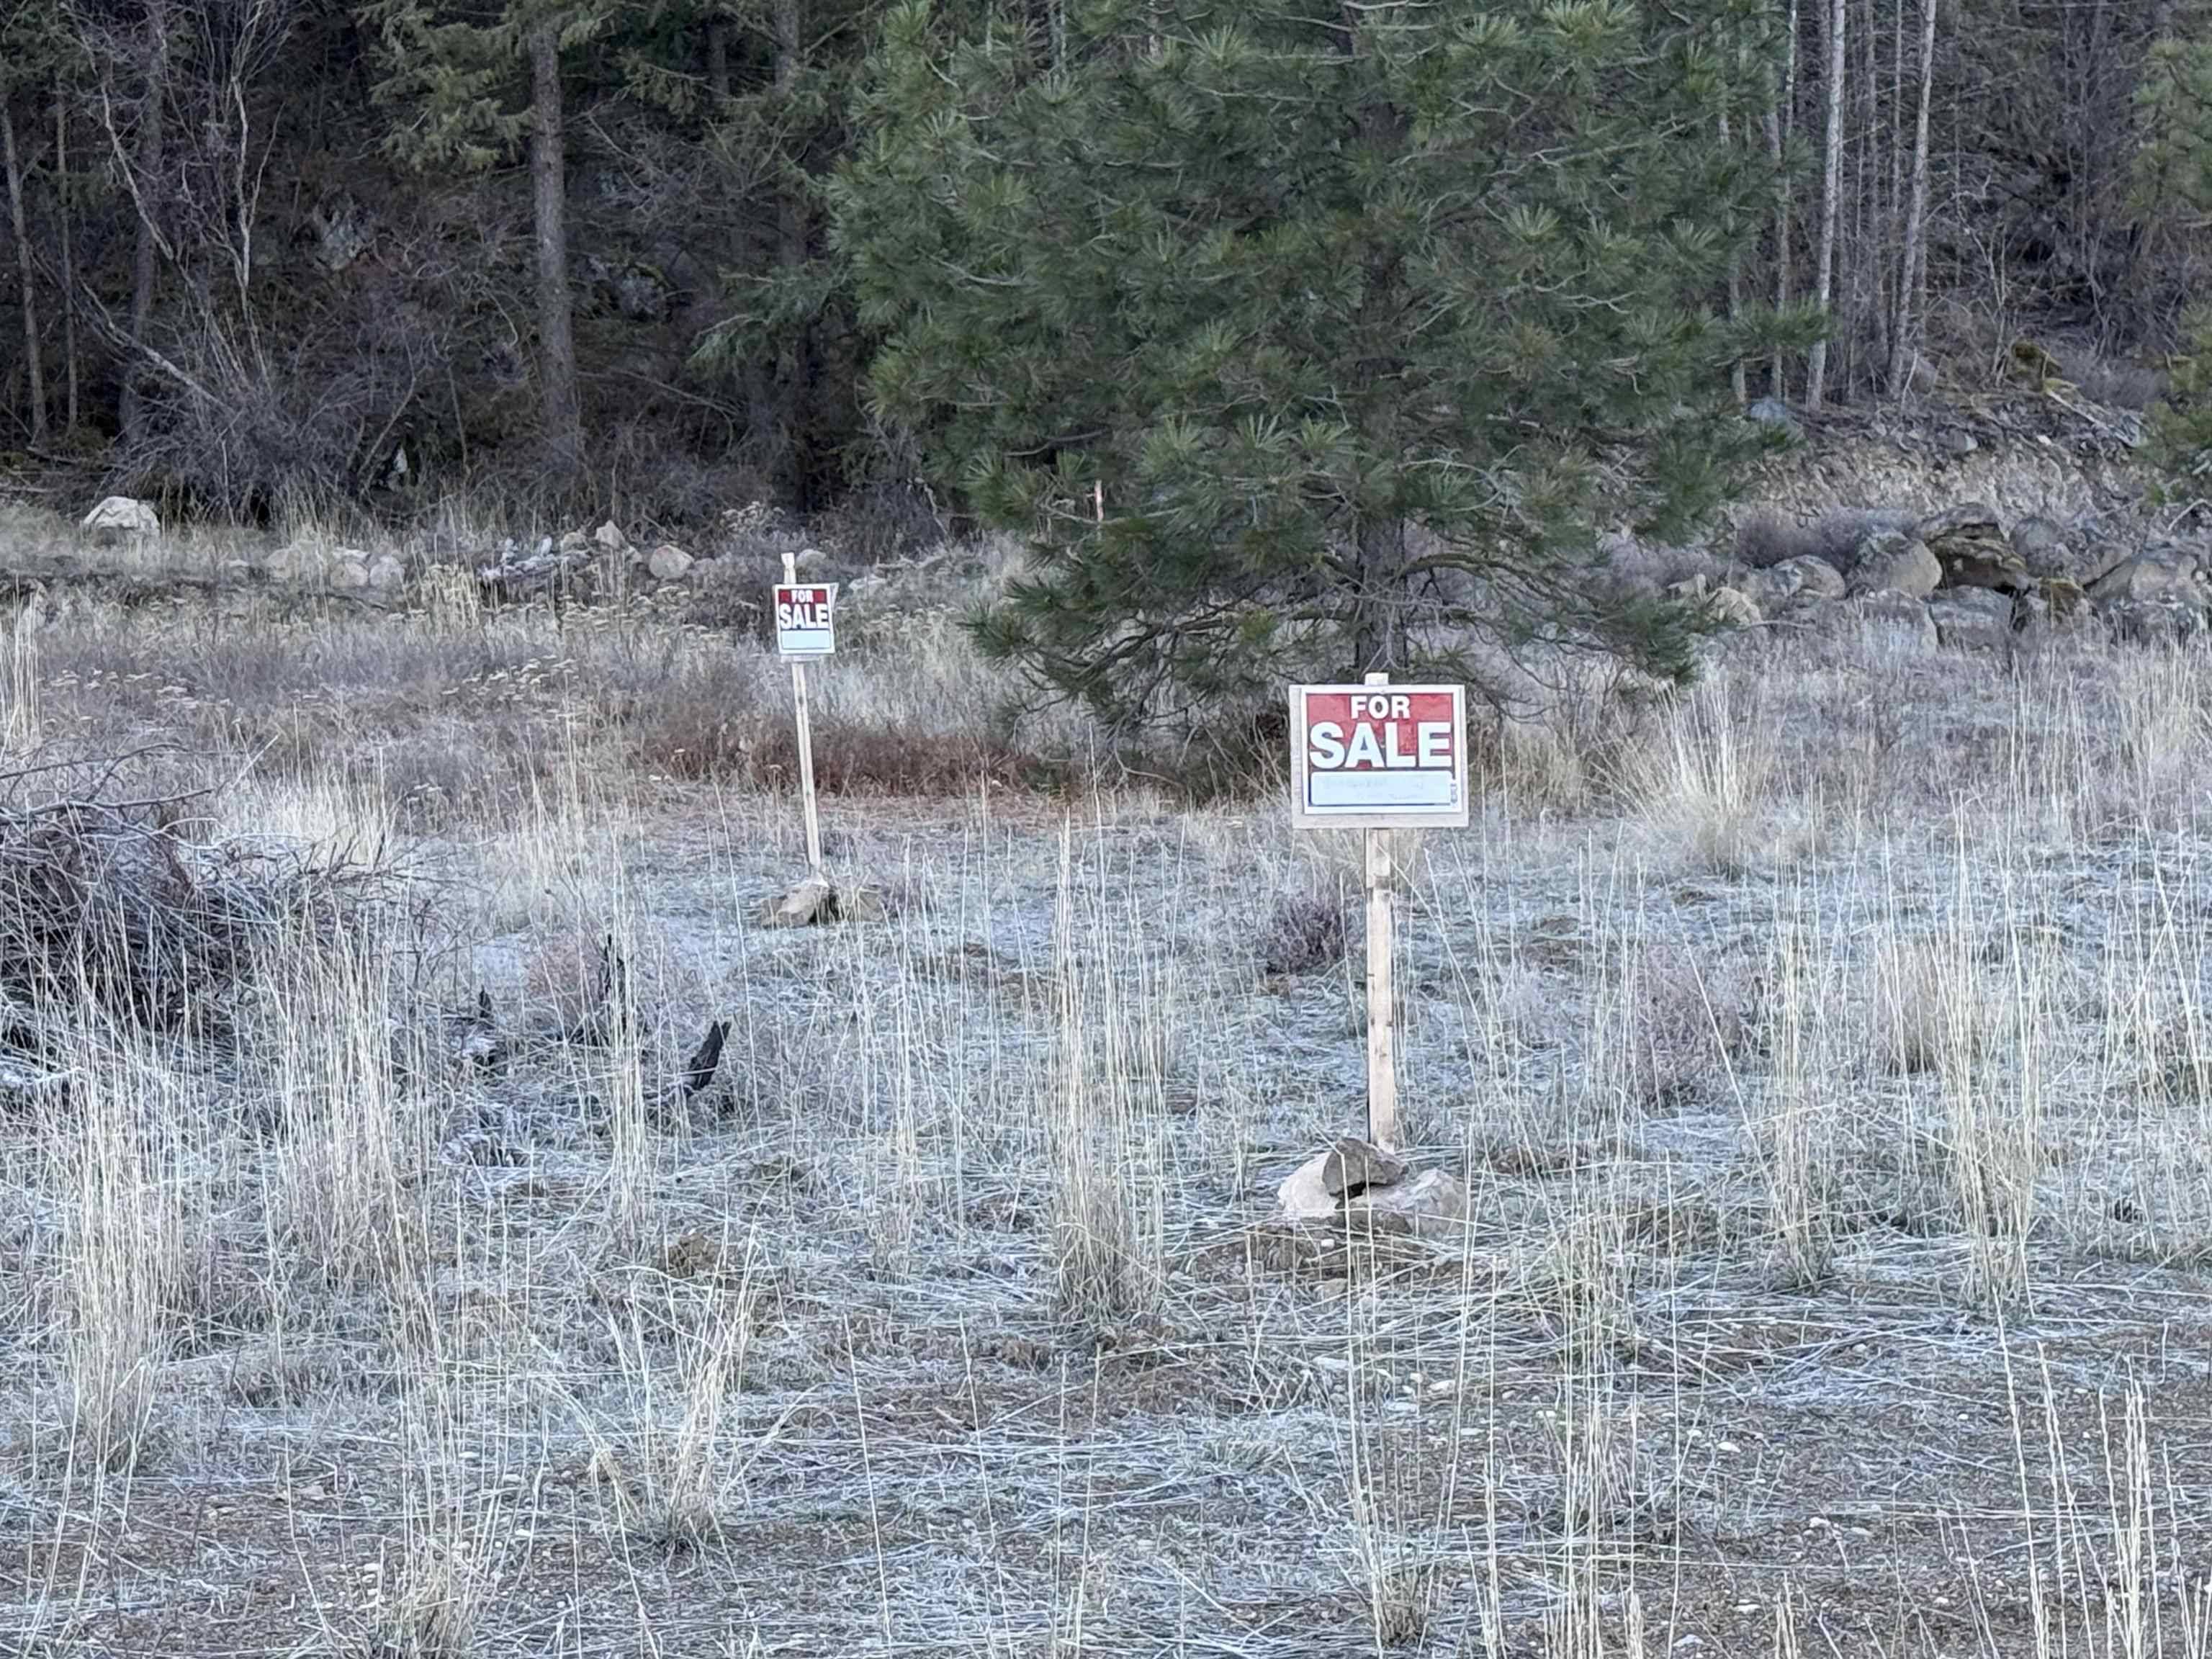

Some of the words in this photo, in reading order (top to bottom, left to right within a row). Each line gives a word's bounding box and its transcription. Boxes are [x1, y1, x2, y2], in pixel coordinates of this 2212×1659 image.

[791, 590, 814, 603] FOR
[780, 603, 829, 629] SALE
[1351, 695, 1411, 719] FOR
[1309, 721, 1452, 769] SALE
